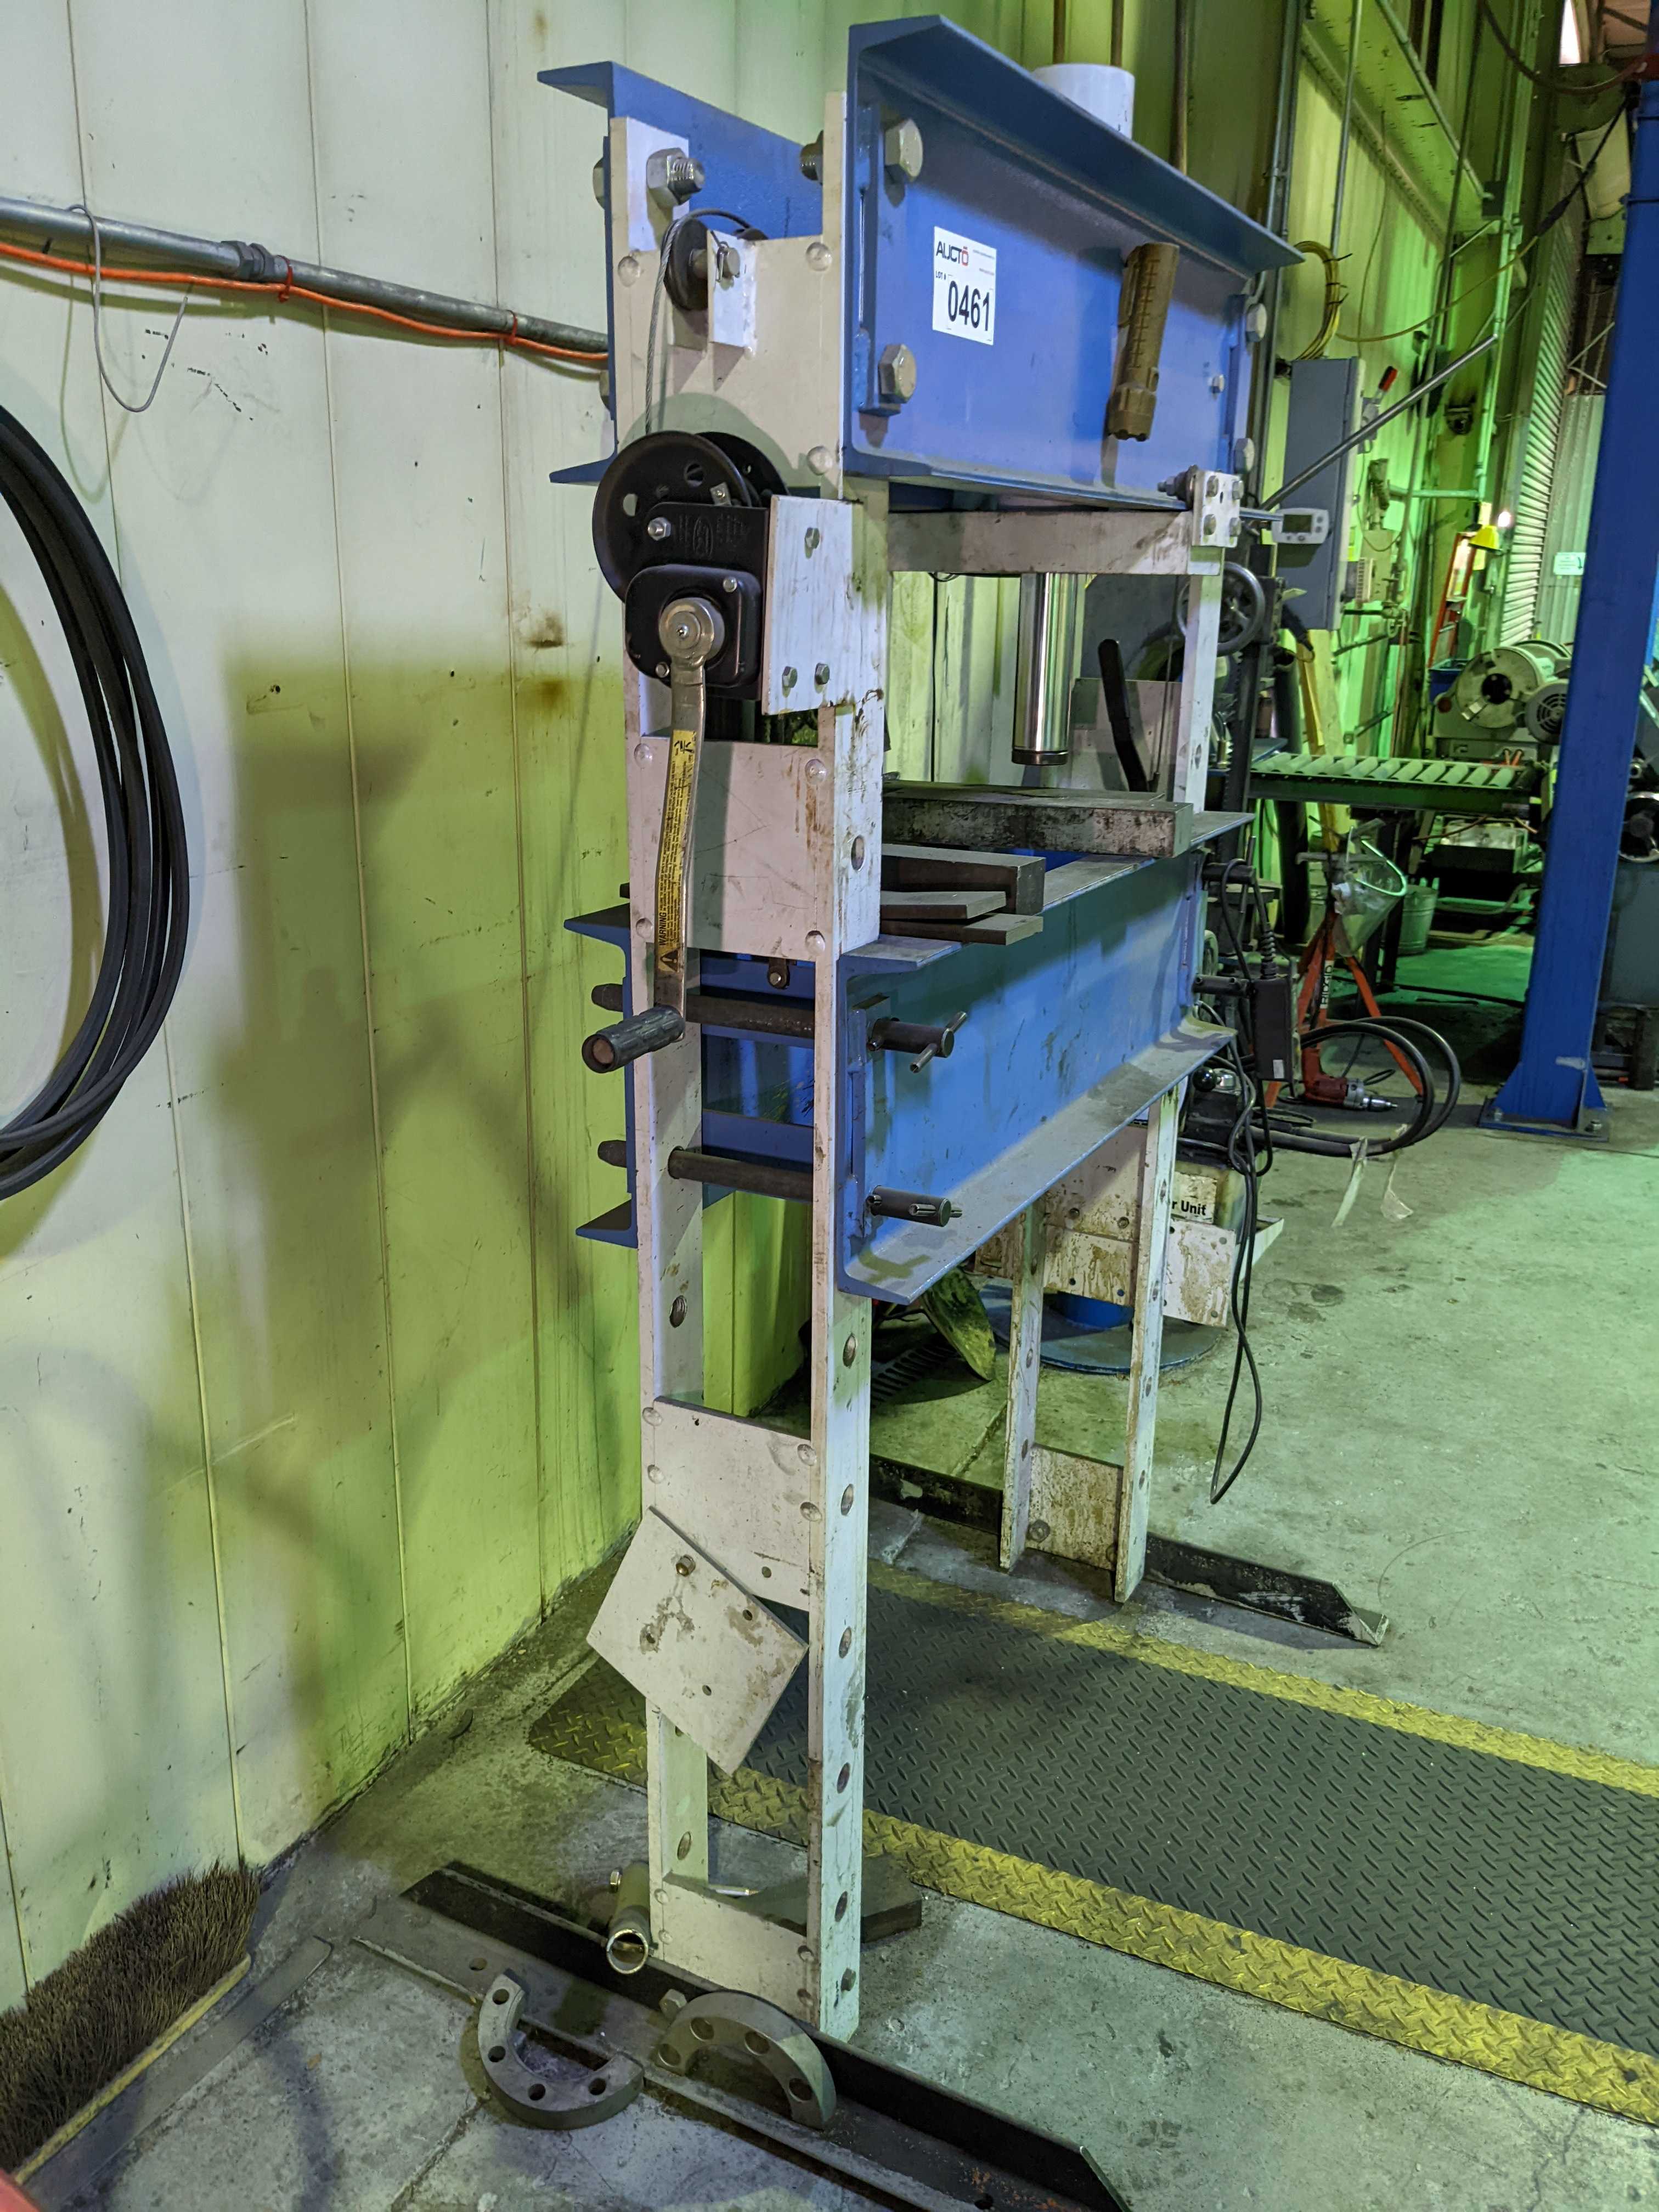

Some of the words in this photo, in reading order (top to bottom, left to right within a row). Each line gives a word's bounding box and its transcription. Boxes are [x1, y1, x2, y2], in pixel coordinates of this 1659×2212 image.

[948, 280, 990, 331] 0461
[659, 912, 667, 945] WARNING
[1181, 1200, 1206, 1216] Unit
